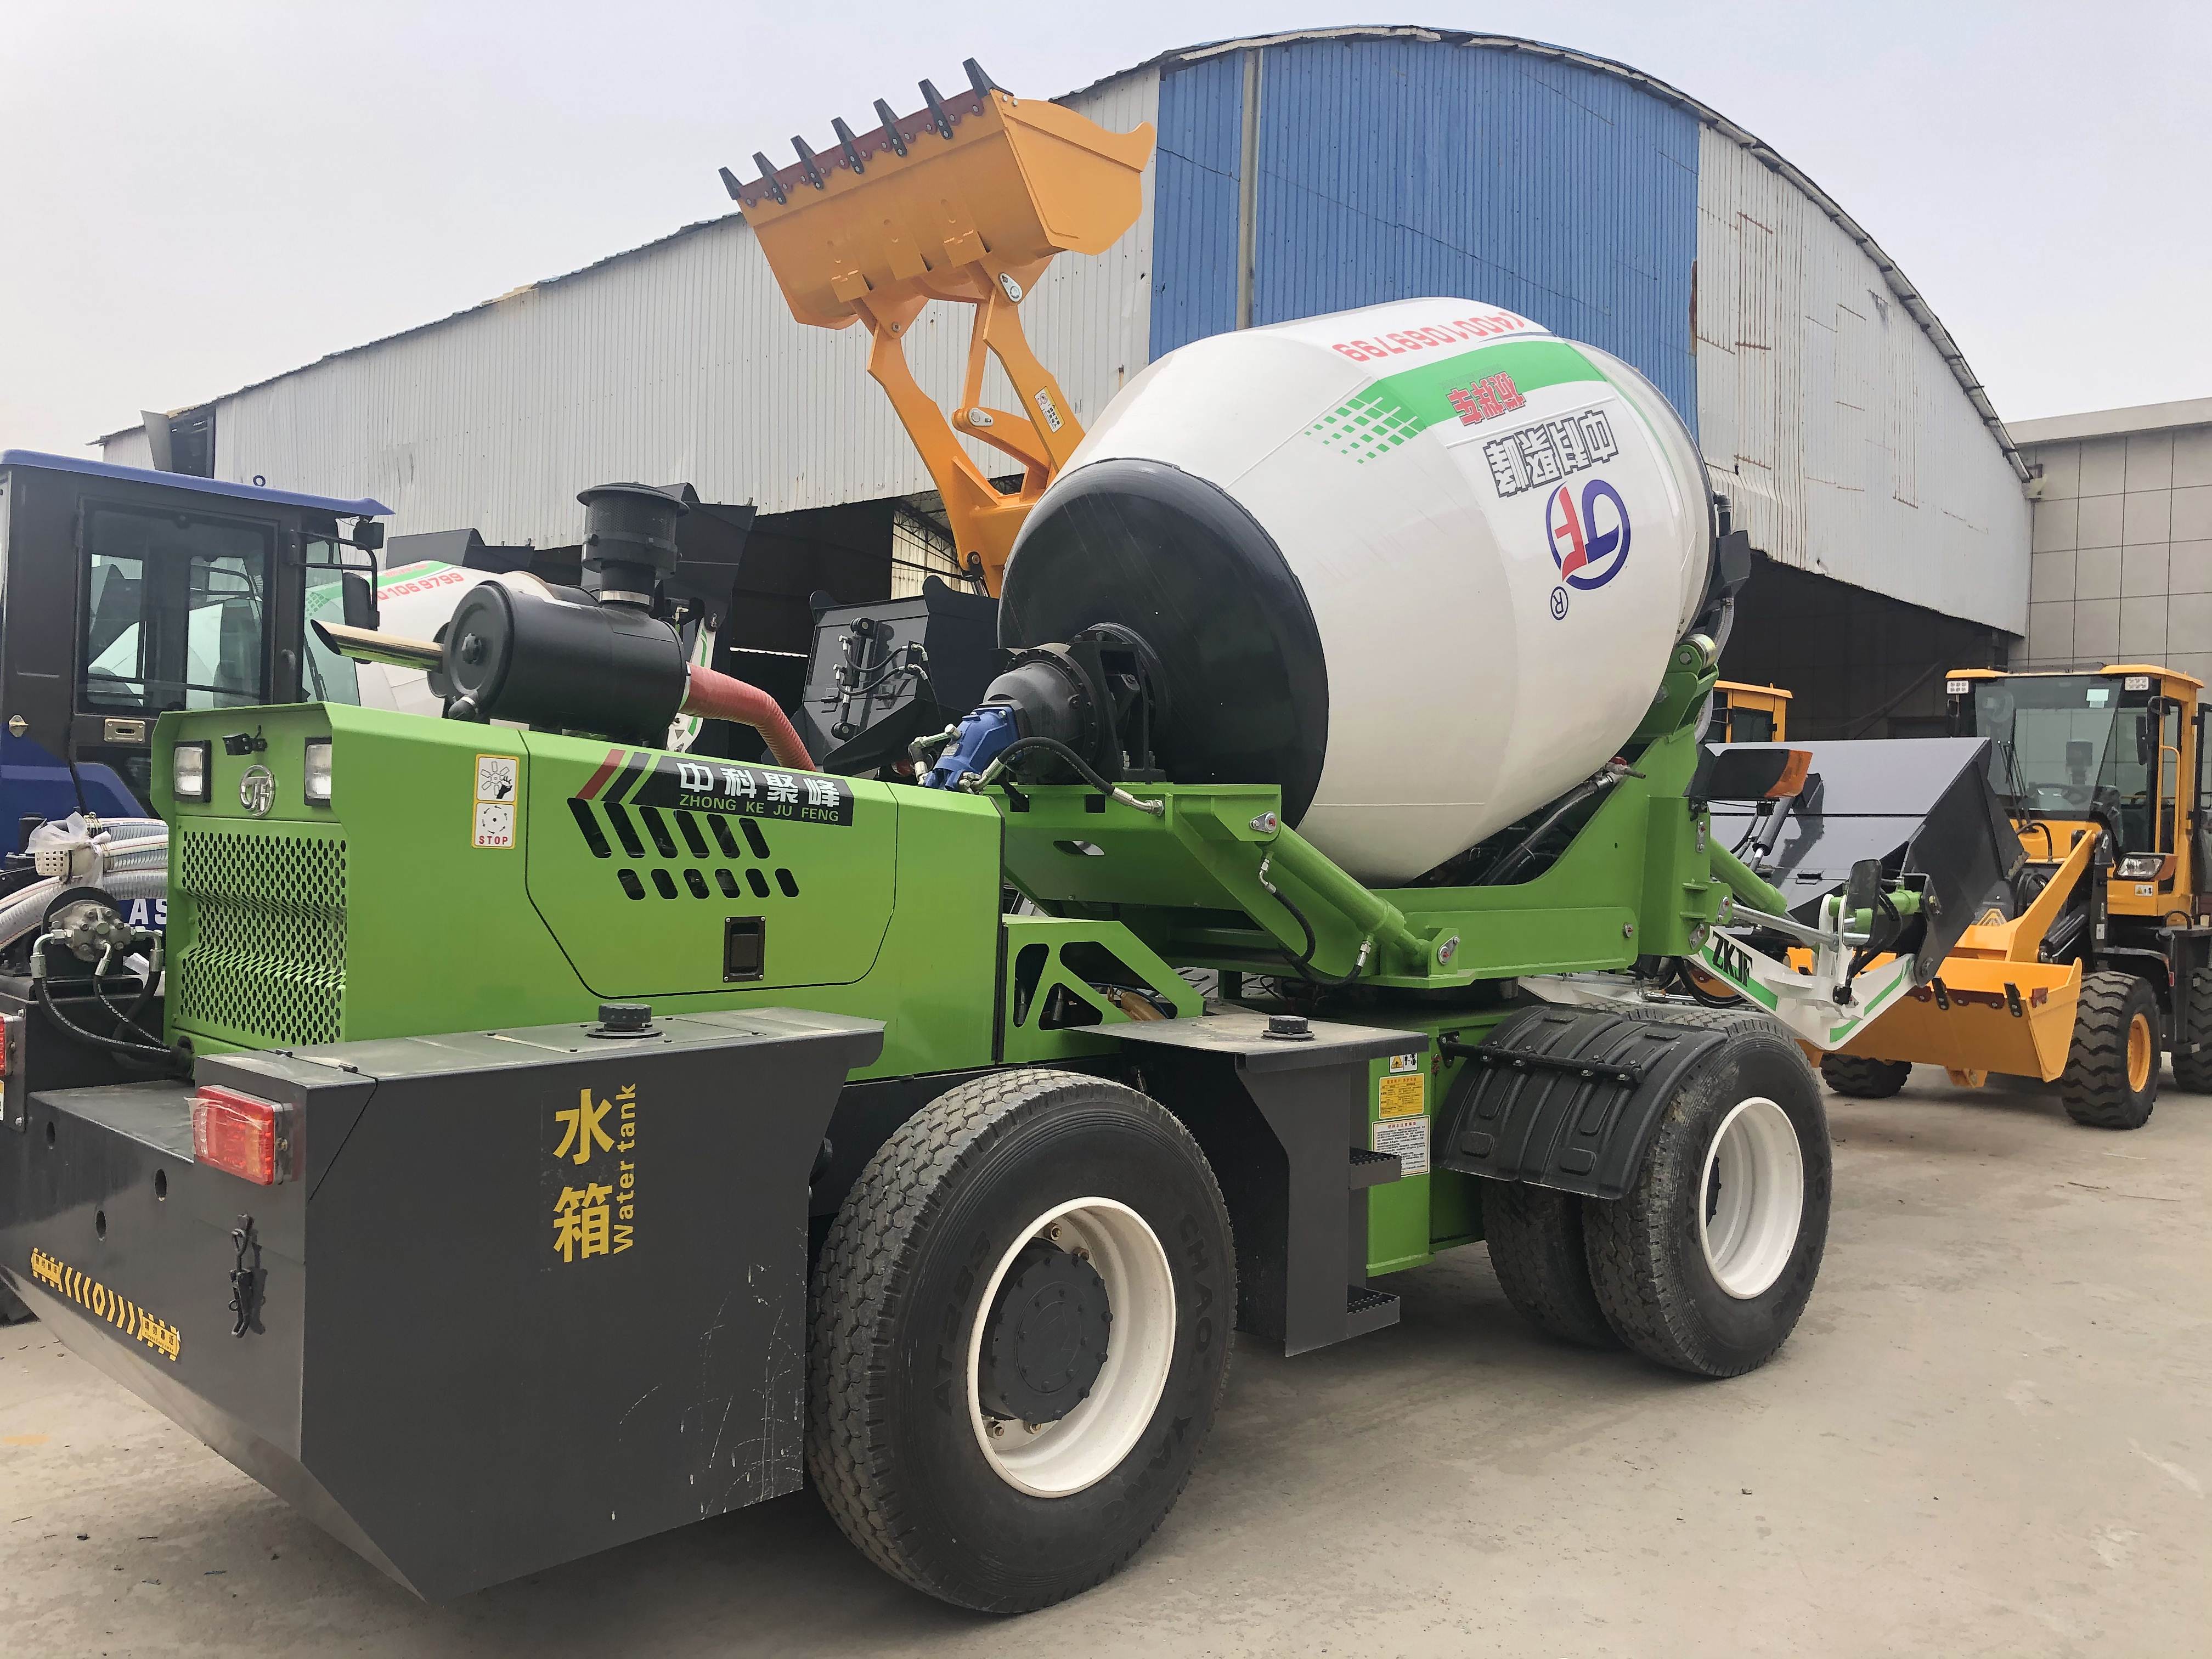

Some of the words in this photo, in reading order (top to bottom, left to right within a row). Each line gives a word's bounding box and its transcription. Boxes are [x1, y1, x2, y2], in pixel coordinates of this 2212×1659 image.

[1446, 371, 1527, 427] 搅拌车
[1482, 410, 1619, 498] 中科聚峰
[676, 762, 840, 808] 中科聚峰
[680, 794, 736, 811] ZHONG
[746, 801, 765, 814] KE
[773, 804, 793, 816] JU
[801, 807, 839, 822] FENG
[479, 836, 508, 845] STOP
[616, 1083, 636, 1153] tank
[552, 1088, 615, 1263] 水箱
[613, 1160, 635, 1255] Water
